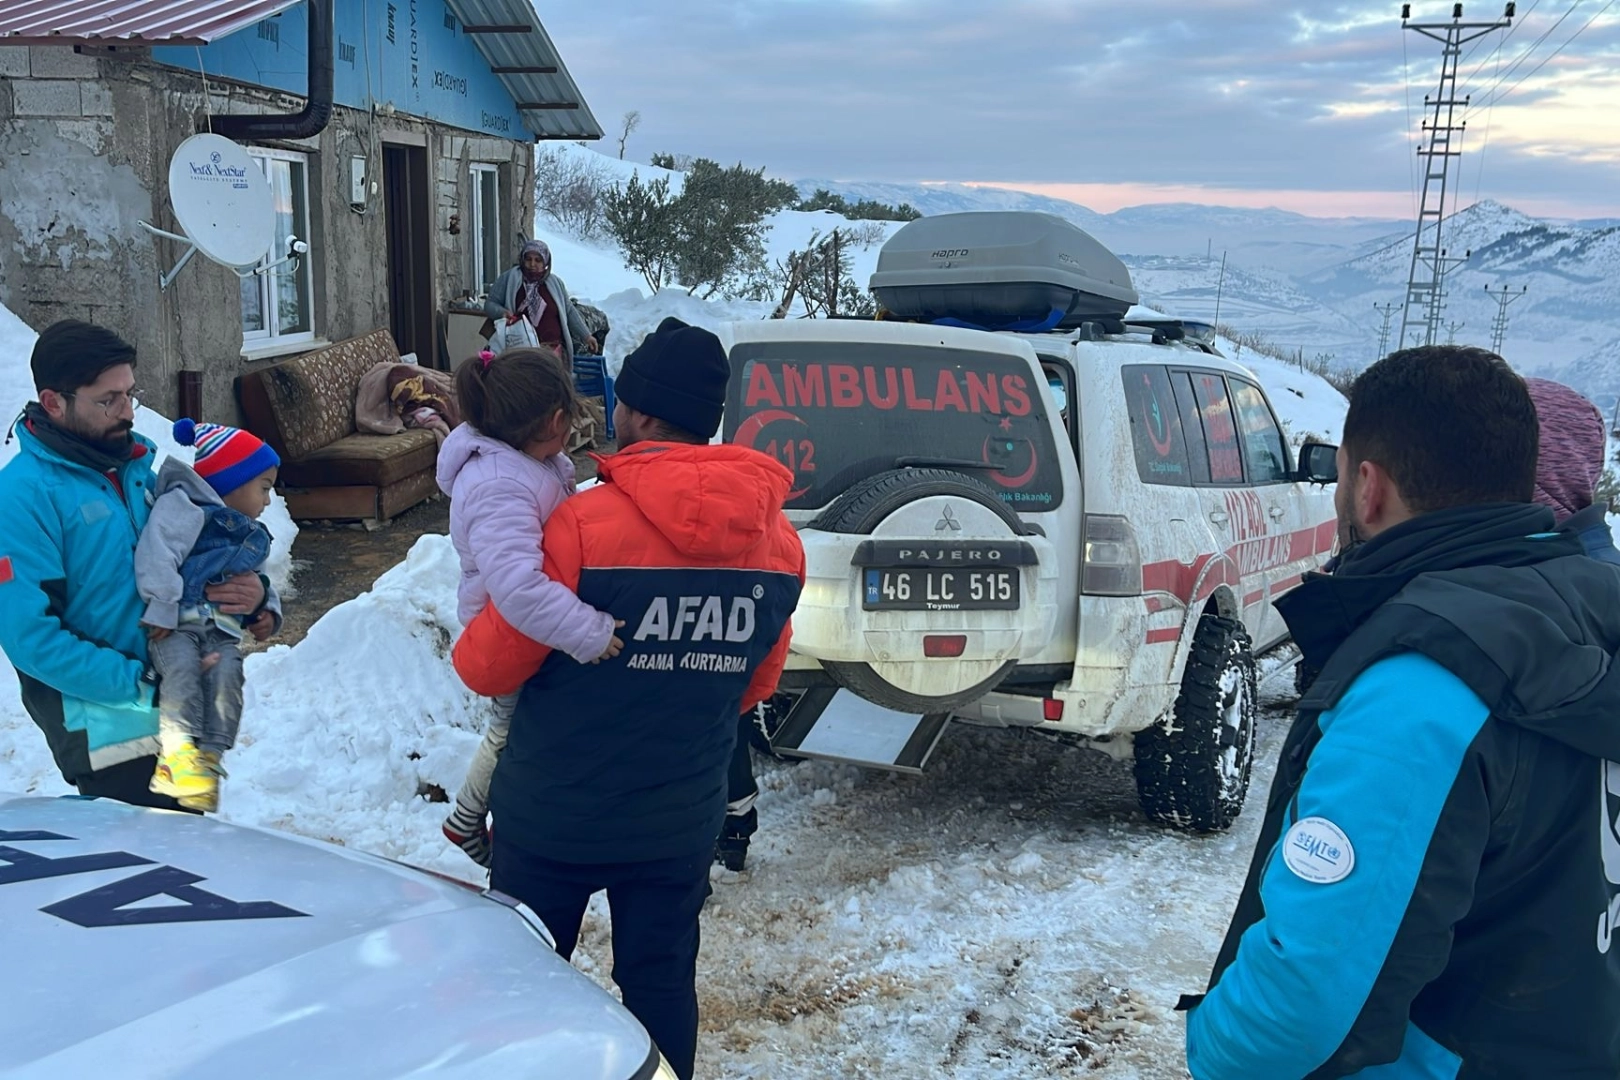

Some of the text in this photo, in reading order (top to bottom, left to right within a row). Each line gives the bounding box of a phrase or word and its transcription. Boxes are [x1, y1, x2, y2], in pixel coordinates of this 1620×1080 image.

[744, 362, 1032, 417] AMBULANS
[899, 549, 1002, 561] PAJERO
[867, 573, 1011, 601] TR 46 LC 515
[633, 595, 756, 643] AFAD
[926, 602, 960, 611] Teymur
[626, 651, 748, 673] ARAMA KURTARMA
